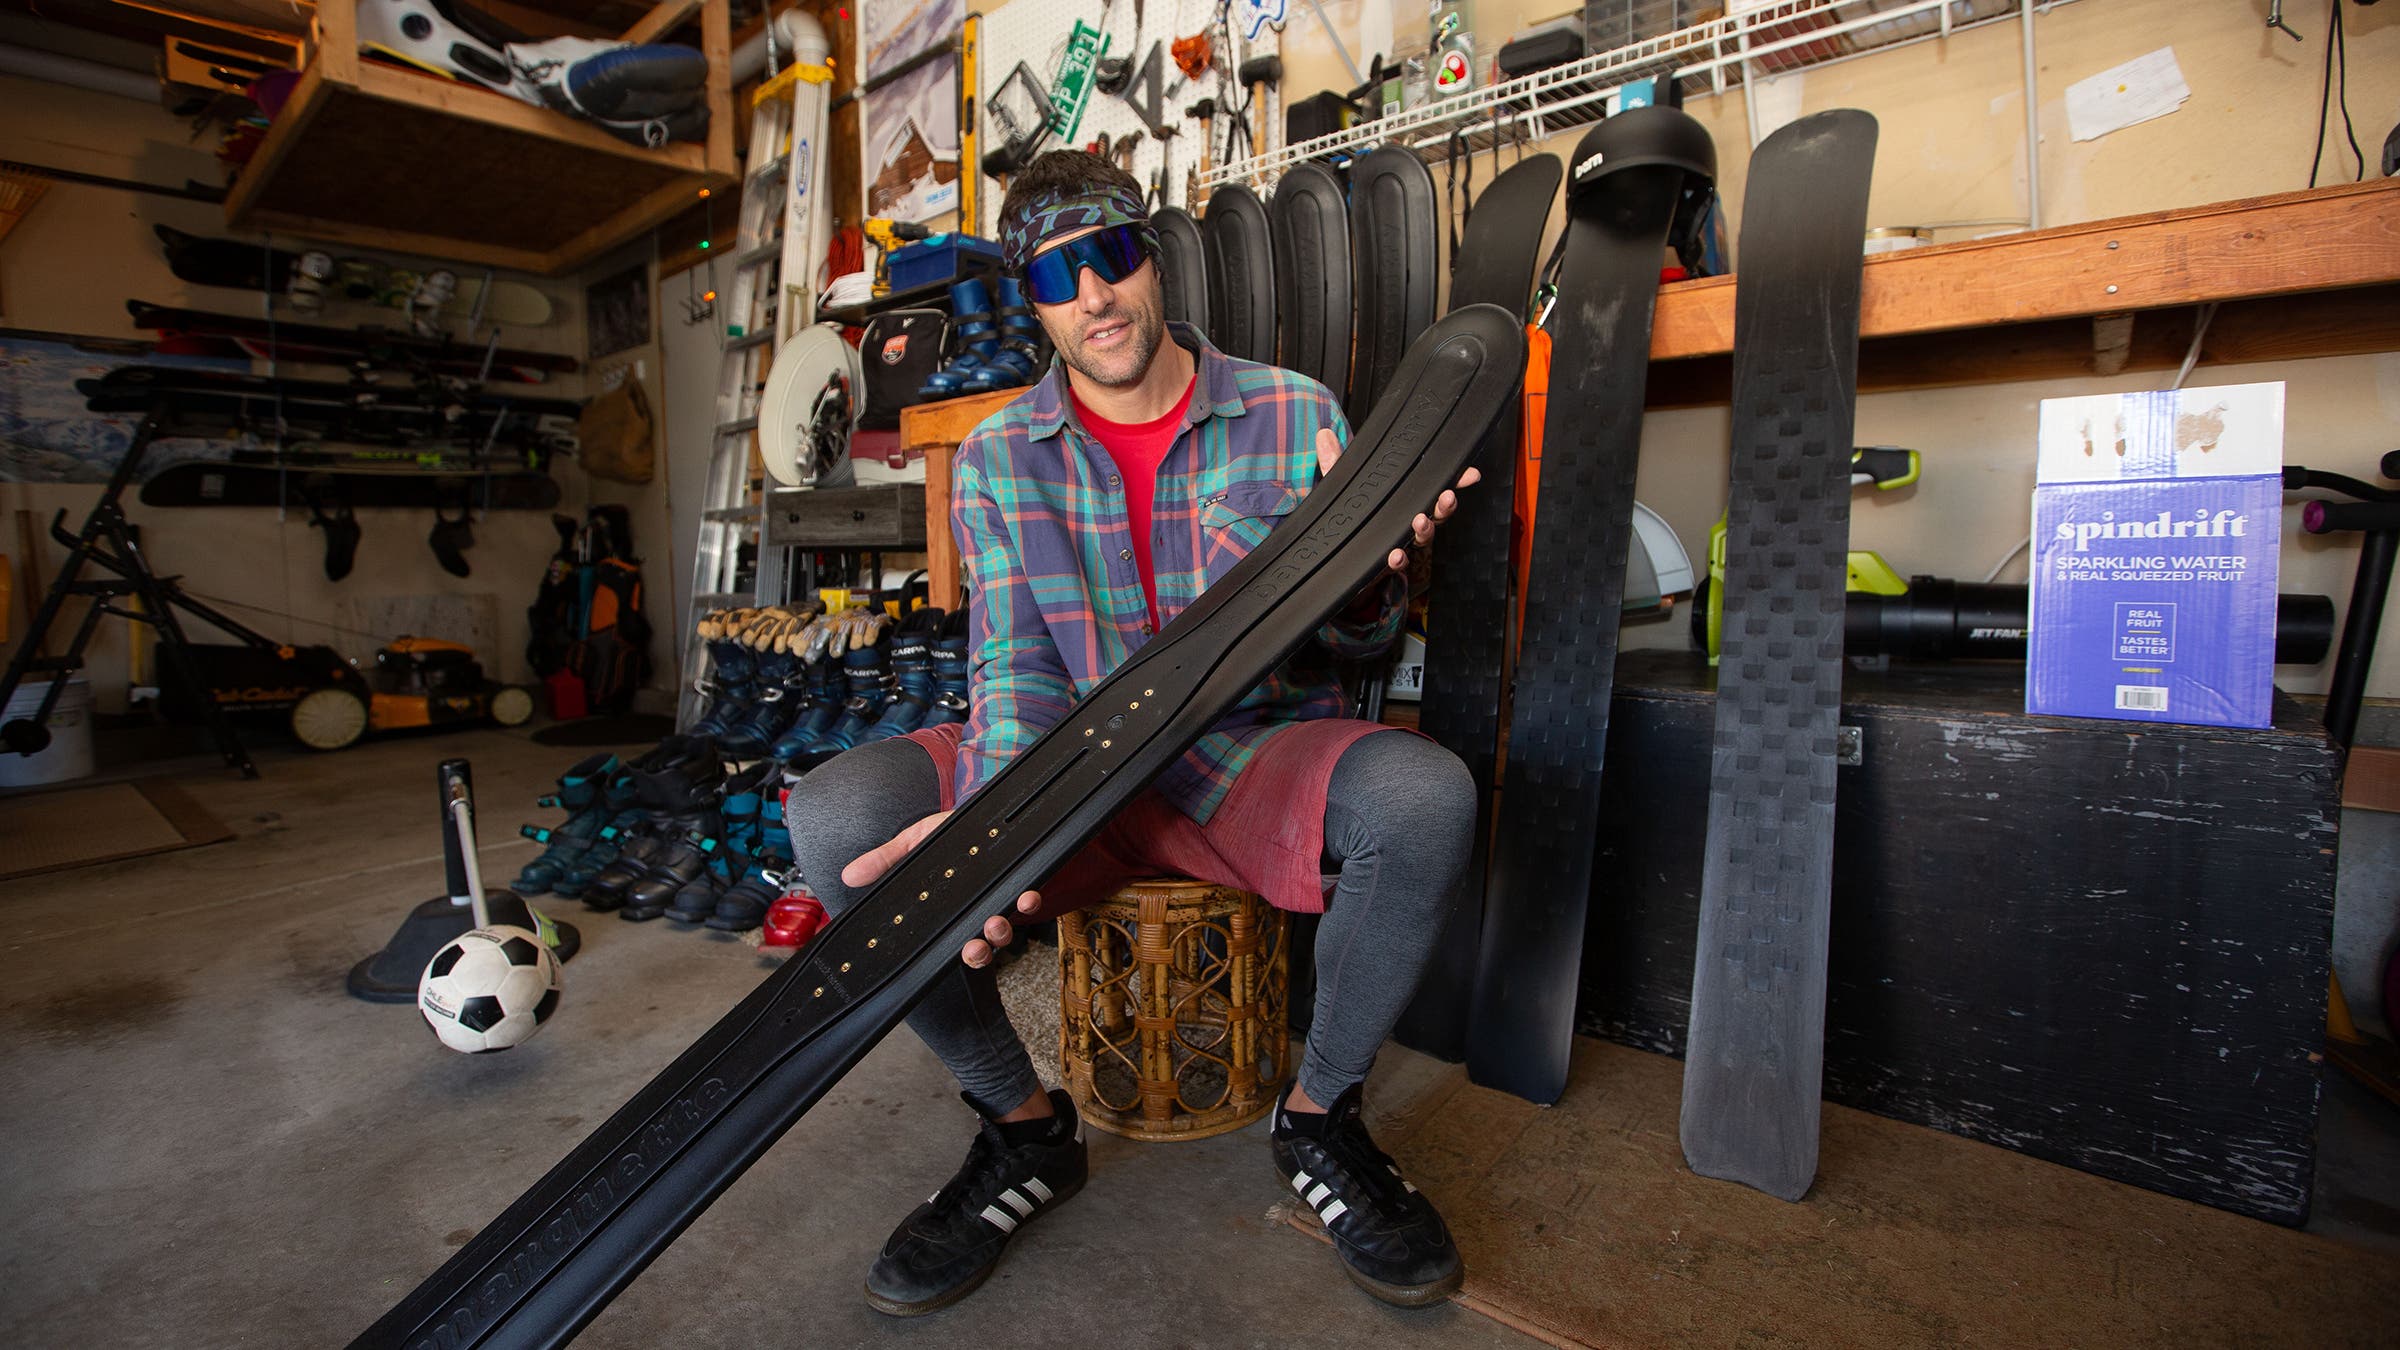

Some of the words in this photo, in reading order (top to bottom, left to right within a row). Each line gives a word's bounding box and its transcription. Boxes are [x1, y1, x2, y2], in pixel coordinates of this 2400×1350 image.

[1247, 388, 1443, 602] backcountry
[2056, 508, 2248, 552] spindrift
[2056, 556, 2166, 570] SPARKLING
[2171, 556, 2247, 569] WATER
[2056, 571, 2067, 581] &
[2069, 571, 2108, 581] REAL
[2111, 571, 2194, 581] SQUEEZED
[2197, 571, 2245, 581] FRUIT
[2128, 609, 2163, 618] REAL
[2126, 619, 2164, 628] FRUIT
[1970, 628, 1994, 638] JET
[1994, 628, 2021, 638] FAN
[2120, 636, 2168, 646] TASTES
[2119, 645, 2169, 655] BETTER
[415, 1077, 727, 1350] marquette
